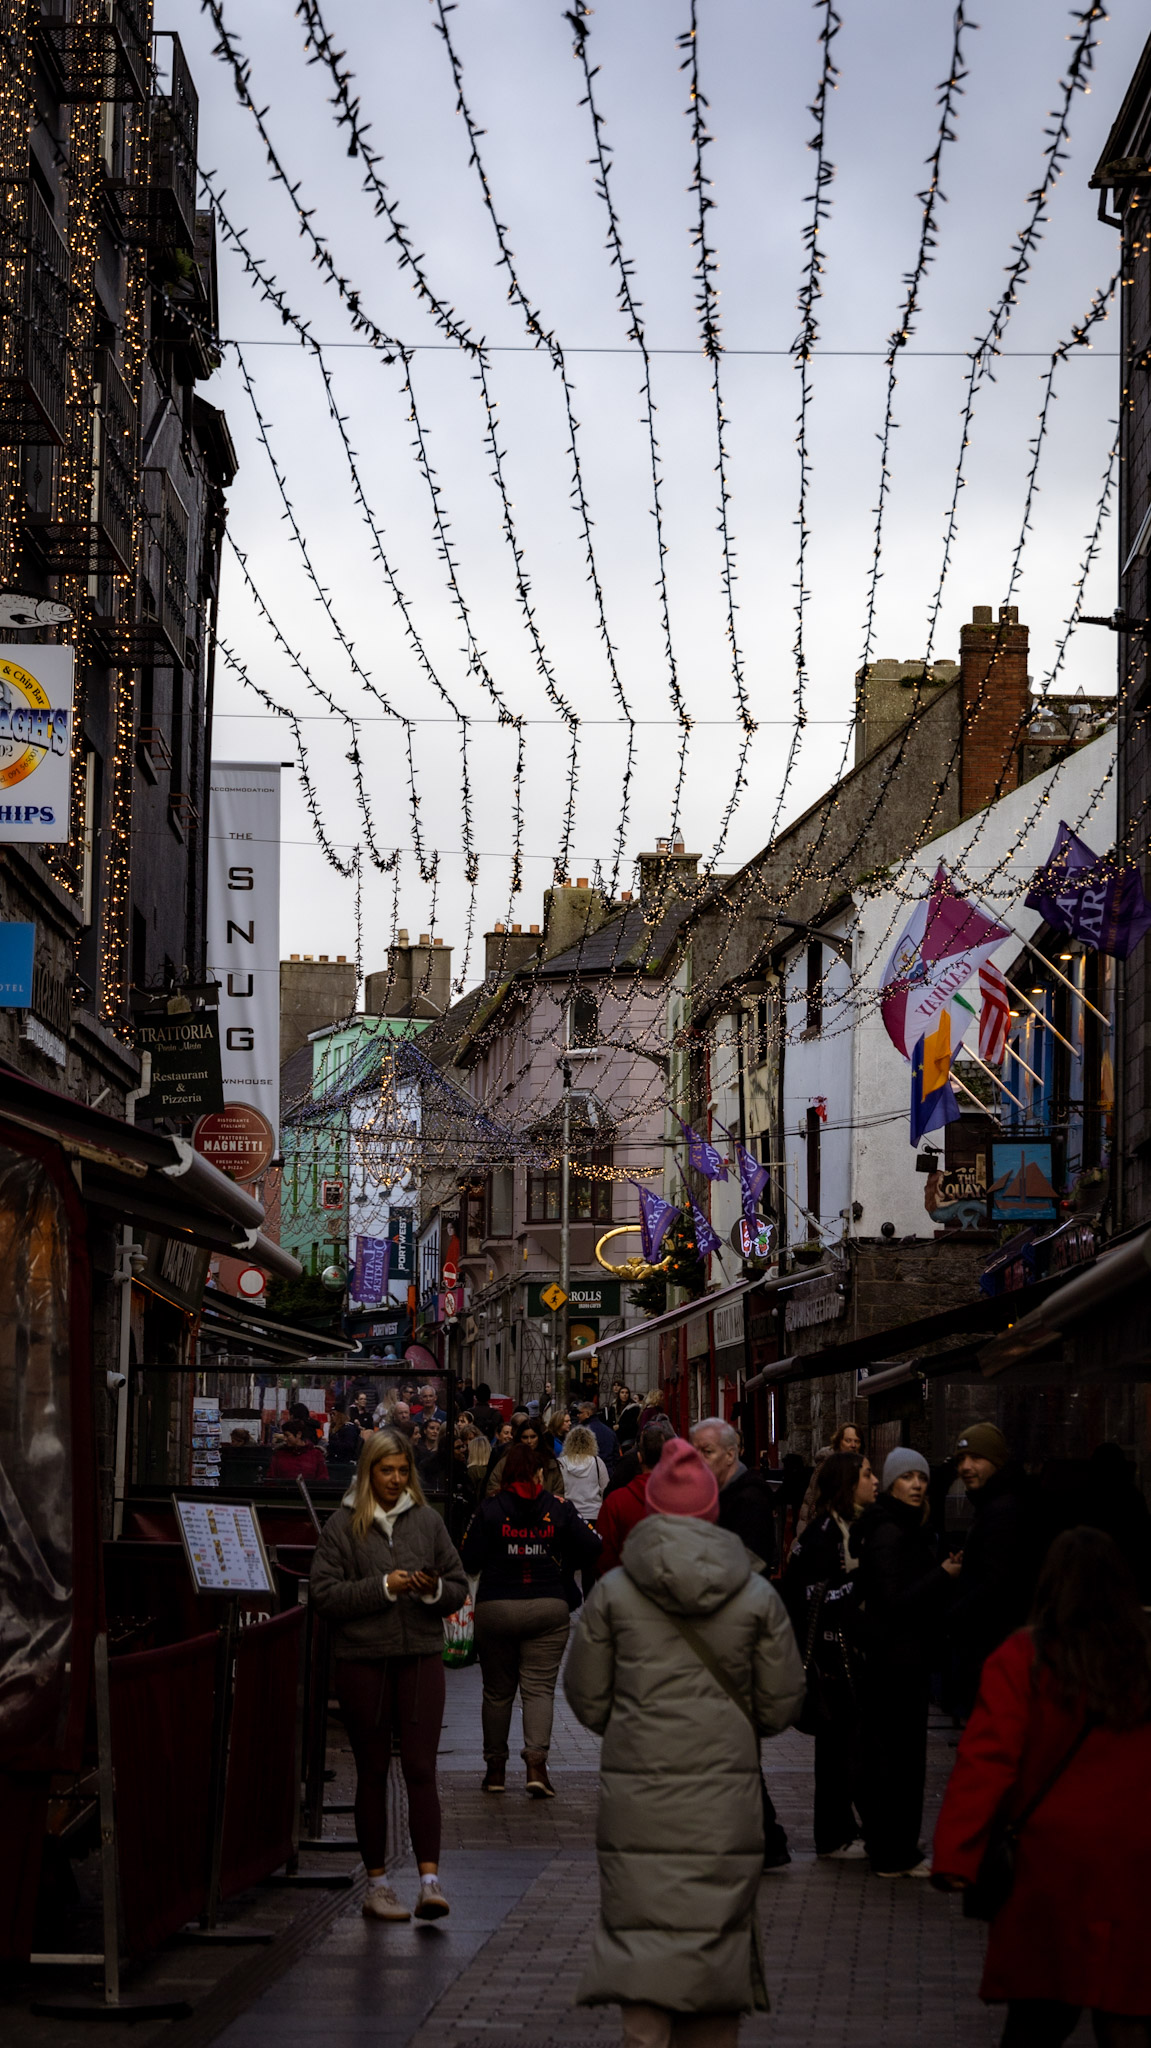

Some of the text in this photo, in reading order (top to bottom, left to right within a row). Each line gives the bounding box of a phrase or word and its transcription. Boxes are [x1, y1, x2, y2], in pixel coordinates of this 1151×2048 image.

[2, 665, 45, 706] & Chip Bar
[0, 707, 68, 757] AGH'S
[0, 805, 56, 824] HIPS
[229, 832, 253, 840] THE
[227, 866, 255, 1051] SNUG
[0, 983, 24, 993] OTEL
[139, 1024, 214, 1043] TRATTORIA
[152, 1070, 209, 1082] Restaurant
[176, 1083, 186, 1093] &
[162, 1093, 202, 1105] Pizzeria
[203, 1140, 263, 1152] MAGNETTI
[945, 1183, 987, 1201] QUAY
[442, 1212, 460, 1220] HIGH
[398, 1216, 407, 1271] PORTWEST
[569, 1291, 602, 1301] ROLLS
[372, 1321, 399, 1337] PORTWEST
